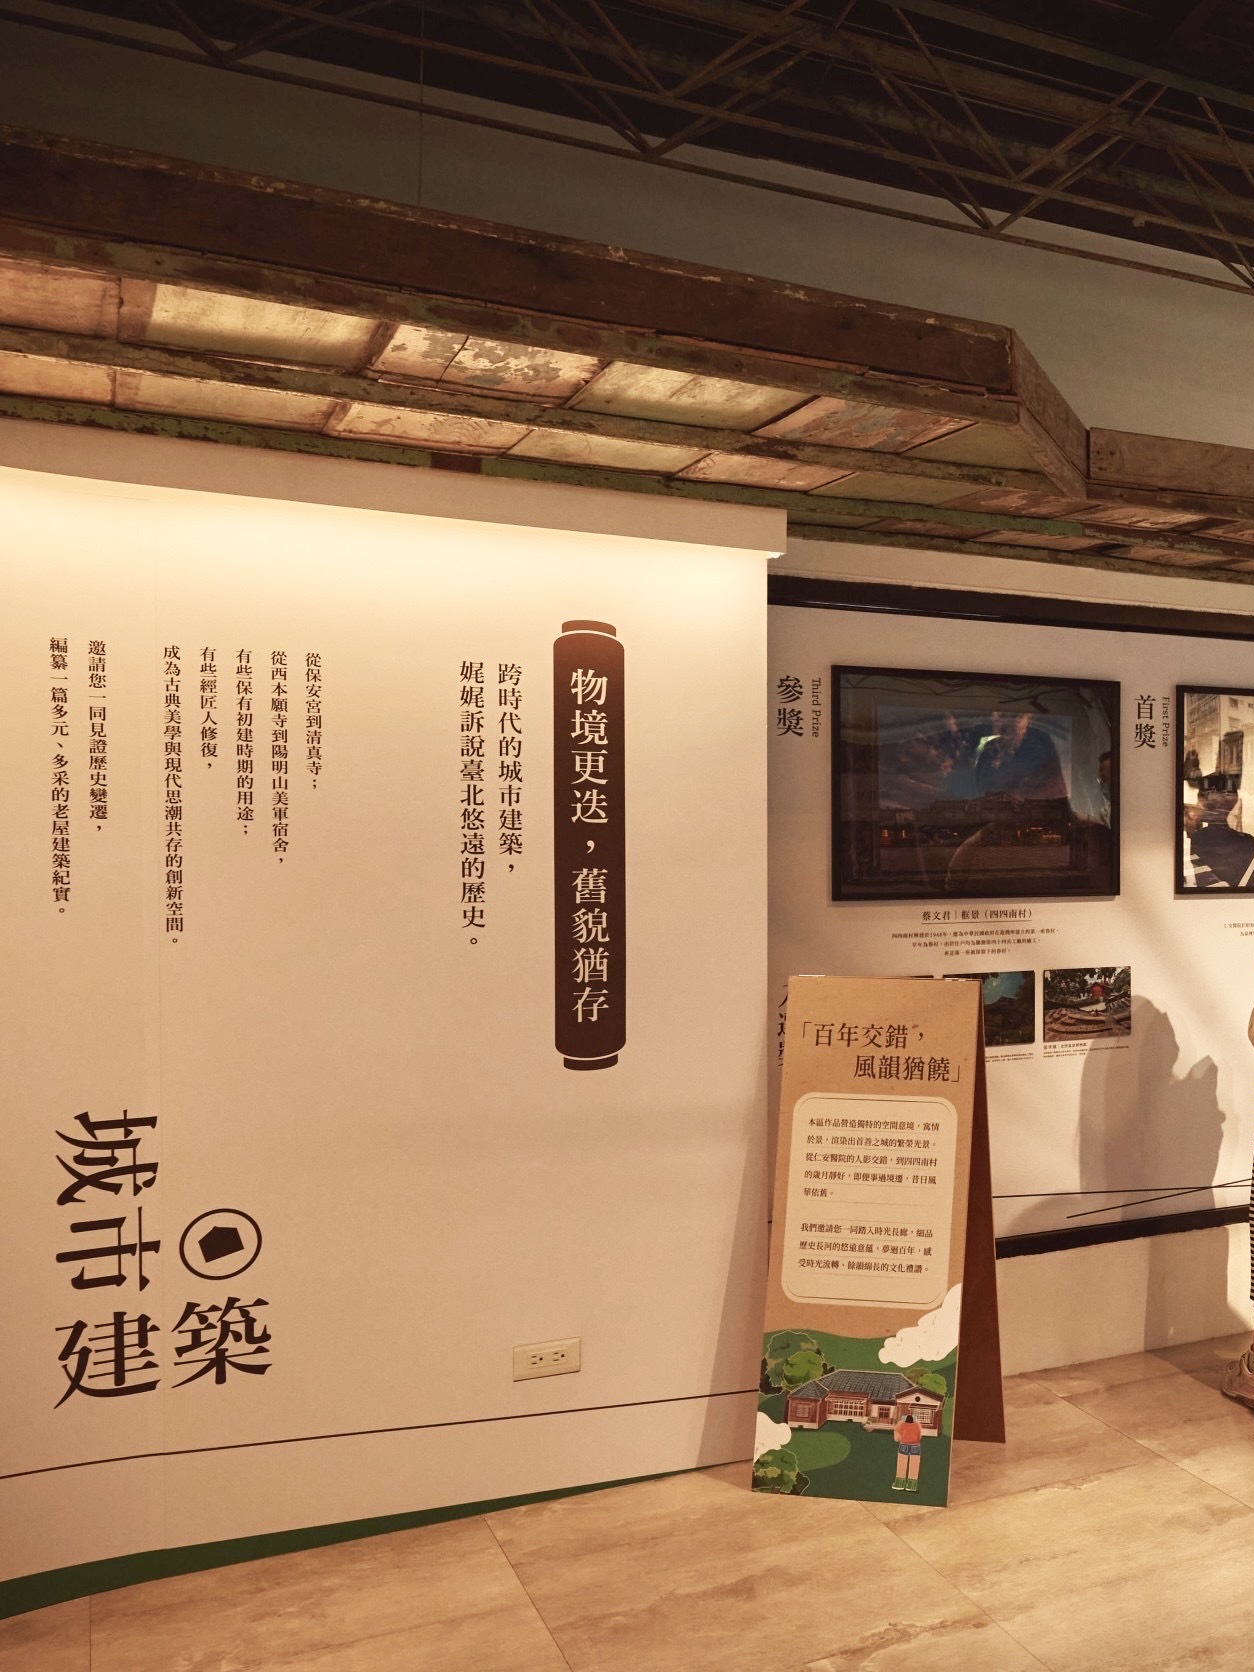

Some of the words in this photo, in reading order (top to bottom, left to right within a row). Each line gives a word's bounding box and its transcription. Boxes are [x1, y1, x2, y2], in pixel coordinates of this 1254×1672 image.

[88, 639, 108, 832] 邀請您一同見證歷史變遷，
[199, 646, 218, 769] 有些經匠人修復，
[235, 648, 254, 836] 有些保有初建時期的用途；
[305, 652, 322, 790] 從保安宮到清真寺；
[776, 675, 804, 737] 參獎
[811, 677, 822, 706] Third
[811, 711, 822, 738] Prize
[1134, 694, 1156, 749] 首獎
[1162, 696, 1170, 719] First
[1162, 723, 1170, 747] Prize
[49, 637, 70, 914] 編纂一篇多元、多采的老屋建築紀實。
[163, 645, 184, 944] 成為古典美學與現代思潮共存的創新空間。
[270, 650, 289, 864] 從西本願寺到陽明山美軍宿舍，
[459, 660, 486, 948] 娓娓訴說臺北悠遠的歷史。
[497, 662, 523, 874] 跨時代的城市建築，
[570, 668, 610, 1024] 物境更迭，舊貌猶存
[802, 1020, 925, 1051] 「百年交錯，
[853, 1054, 961, 1084] 風韻猶饒」
[803, 1186, 834, 1198] 華依舊。
[805, 1152, 938, 1168] 從仁安醫院的人影交錯，到四四南村
[53, 1296, 273, 1410] 建築
